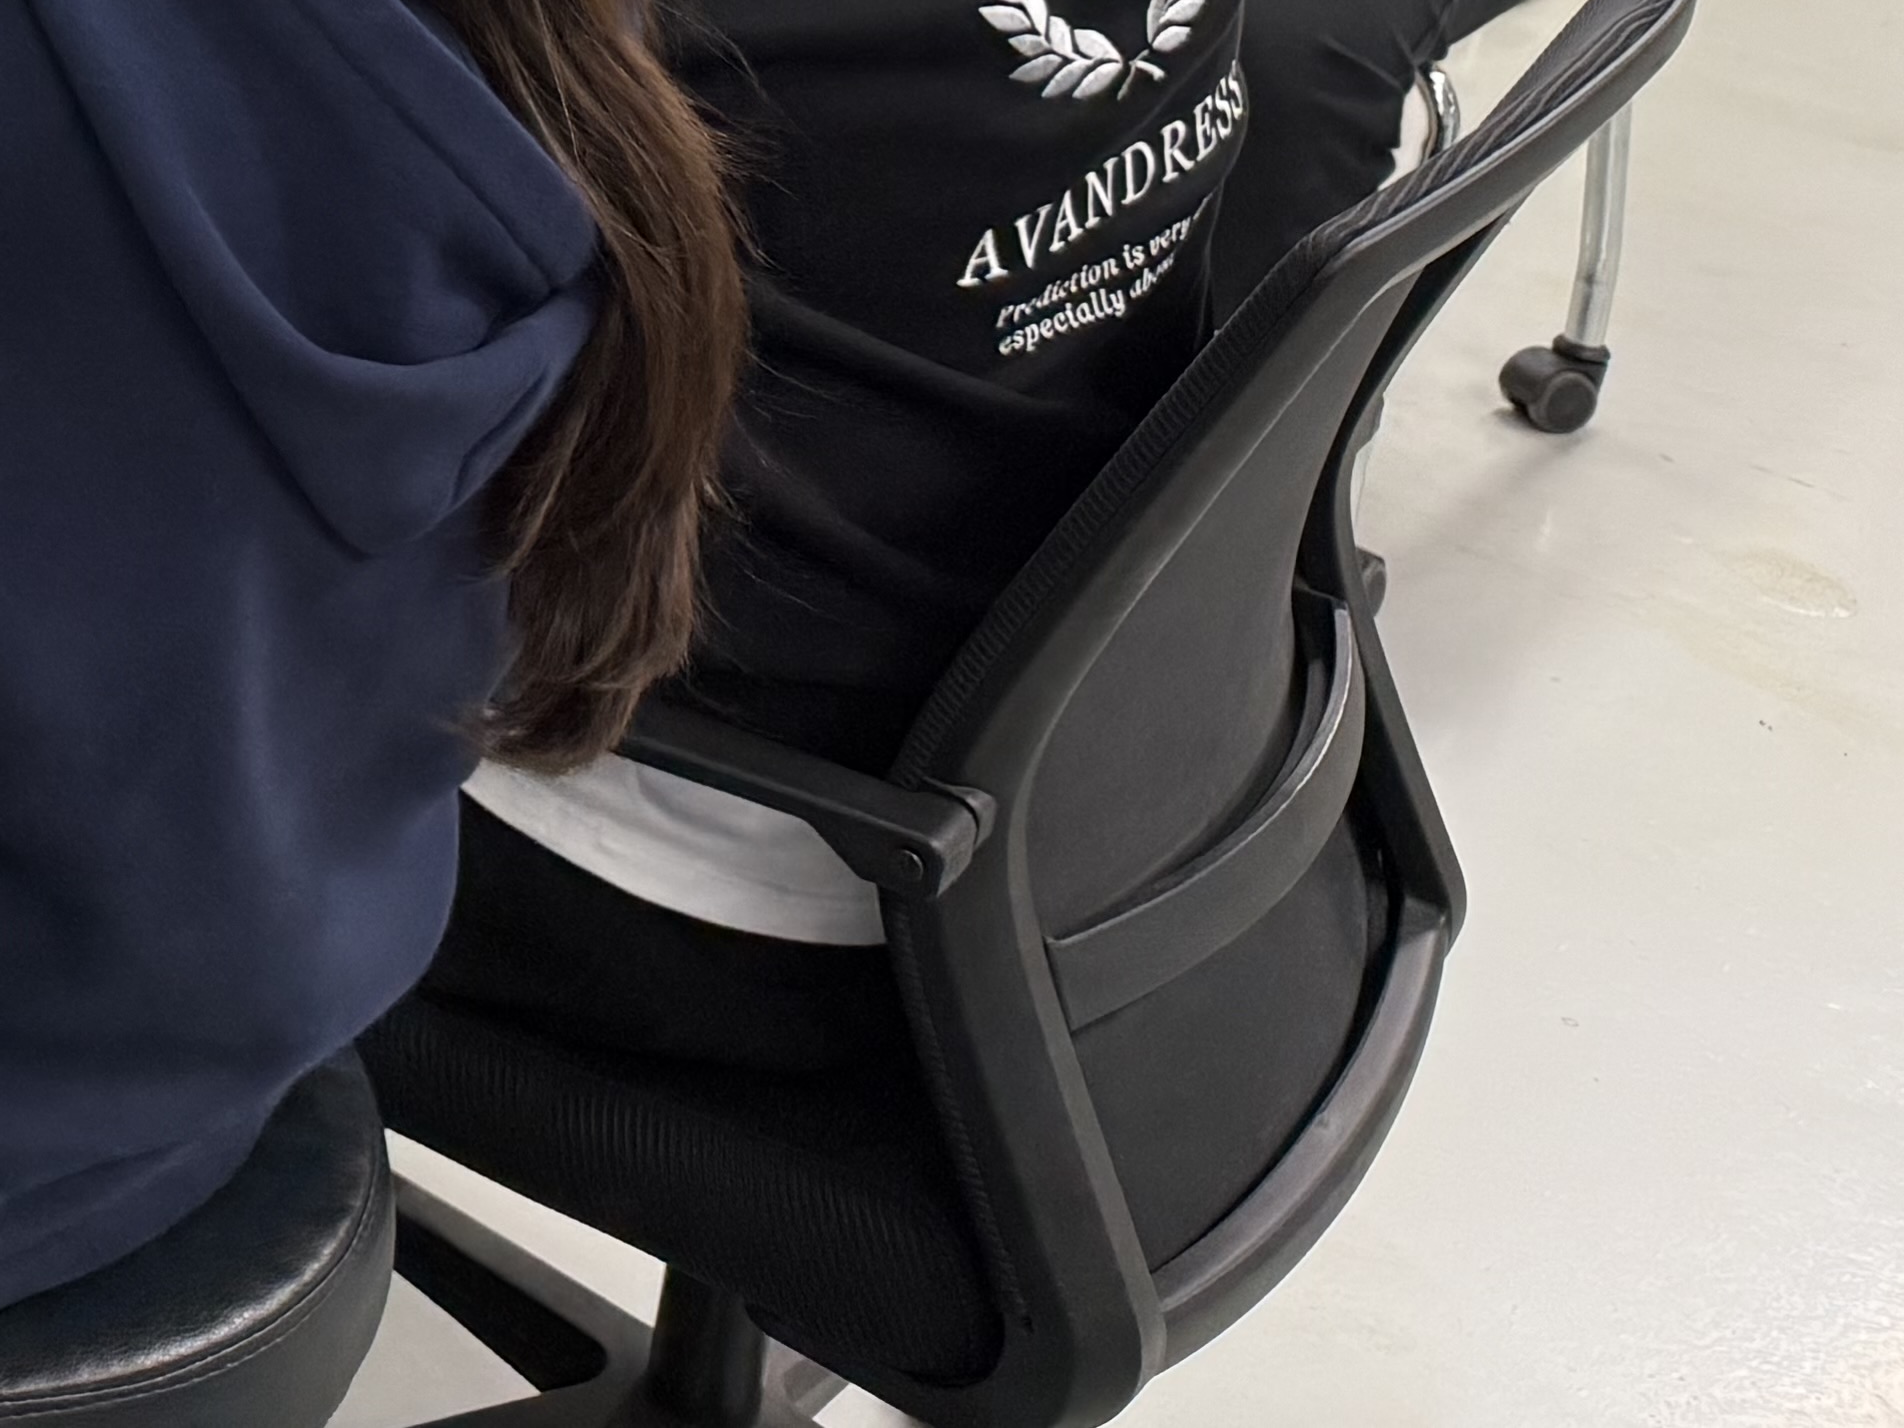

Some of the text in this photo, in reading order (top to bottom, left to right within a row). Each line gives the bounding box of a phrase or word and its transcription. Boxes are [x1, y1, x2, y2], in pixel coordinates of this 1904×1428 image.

[995, 256, 1121, 329] Prediction
[1122, 243, 1146, 271] is
[998, 287, 1127, 357] especially
